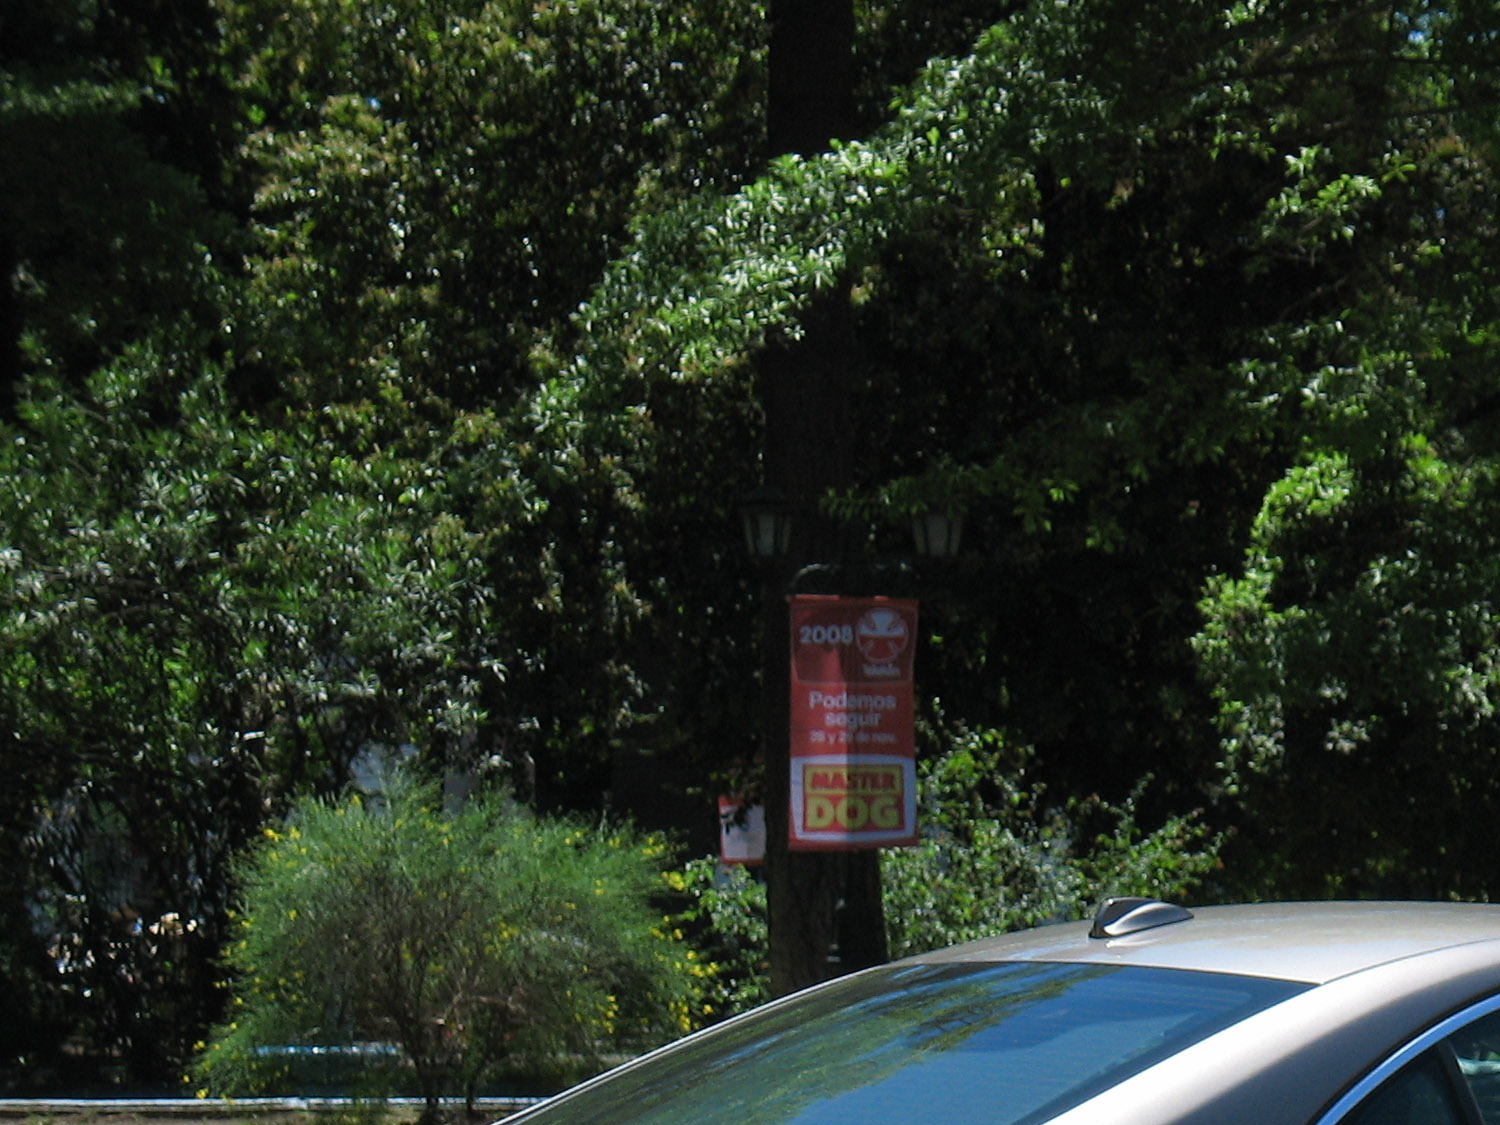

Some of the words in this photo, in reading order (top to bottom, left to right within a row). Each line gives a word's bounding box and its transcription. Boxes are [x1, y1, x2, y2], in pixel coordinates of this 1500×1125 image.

[799, 624, 854, 645] 2008
[809, 690, 897, 710] Podemos
[824, 711, 882, 732] seguir
[810, 770, 896, 791] MASTER
[806, 795, 900, 830] DOG
